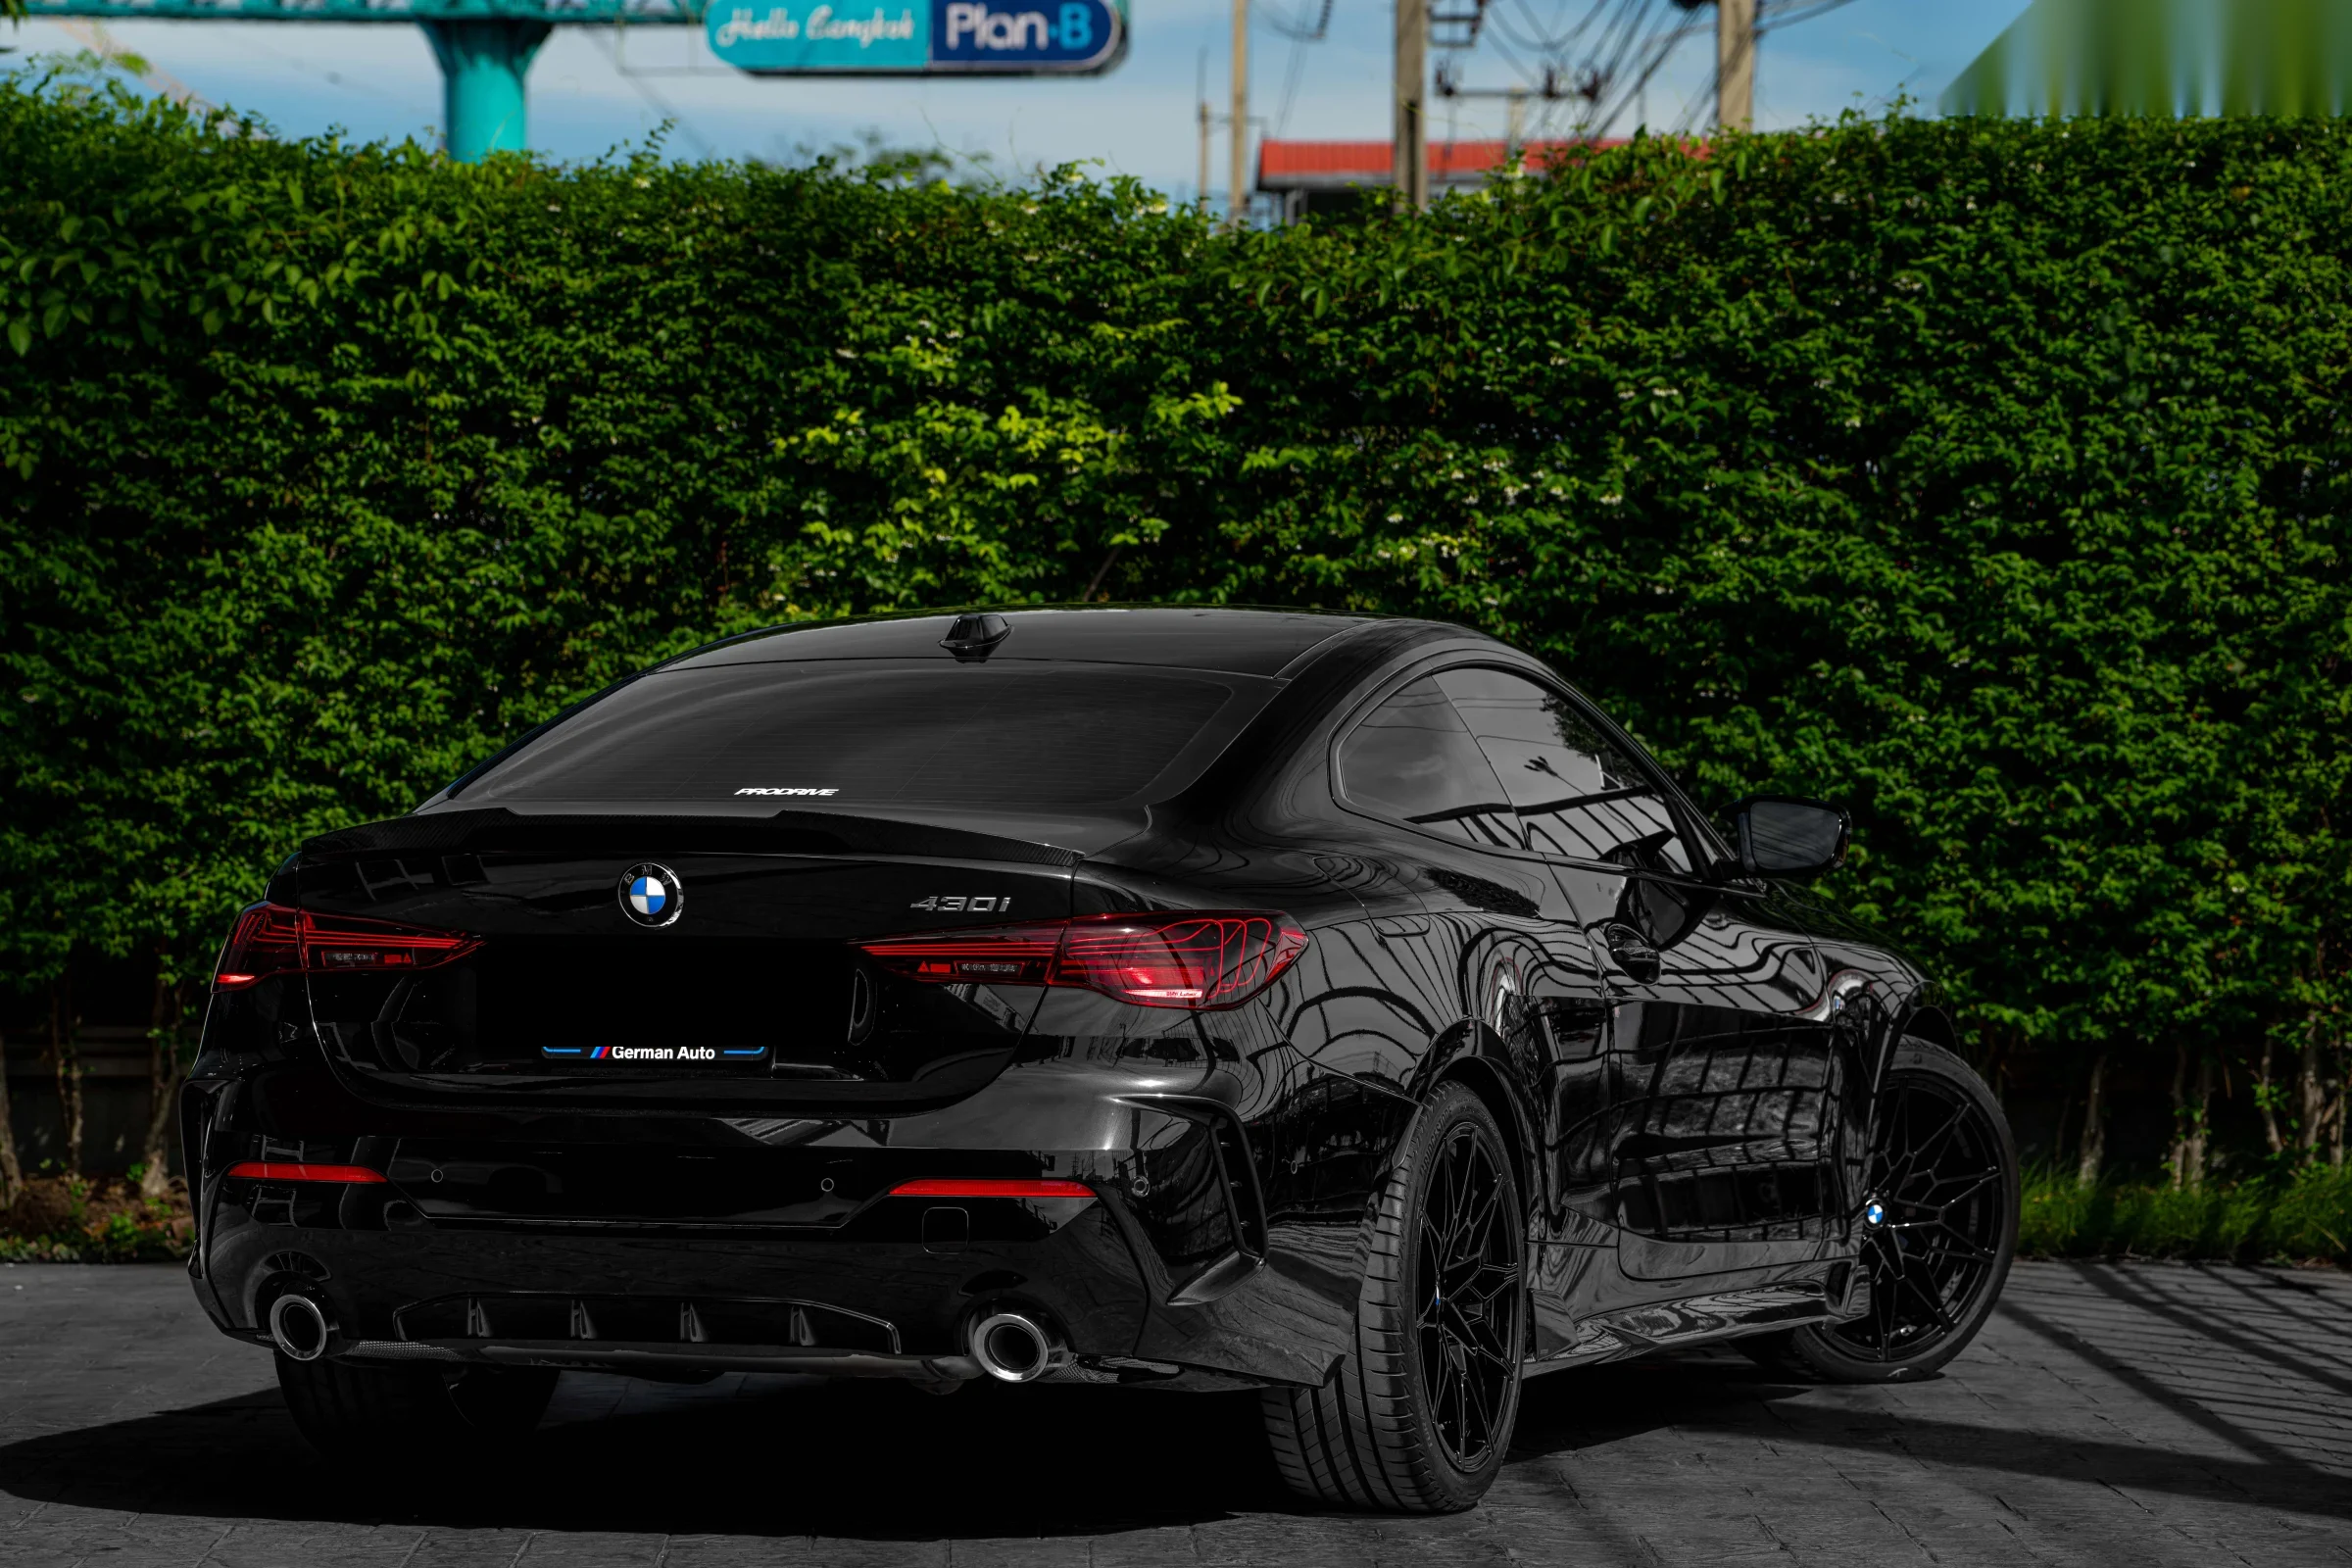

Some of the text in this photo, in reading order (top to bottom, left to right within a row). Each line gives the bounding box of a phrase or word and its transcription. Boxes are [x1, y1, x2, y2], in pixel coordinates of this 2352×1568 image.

[714, 7, 800, 47] Hello
[733, 787, 840, 796] PRODRIVE
[624, 864, 672, 886] BMW
[909, 896, 1011, 912] 430i
[612, 1046, 715, 1060] German Auto
